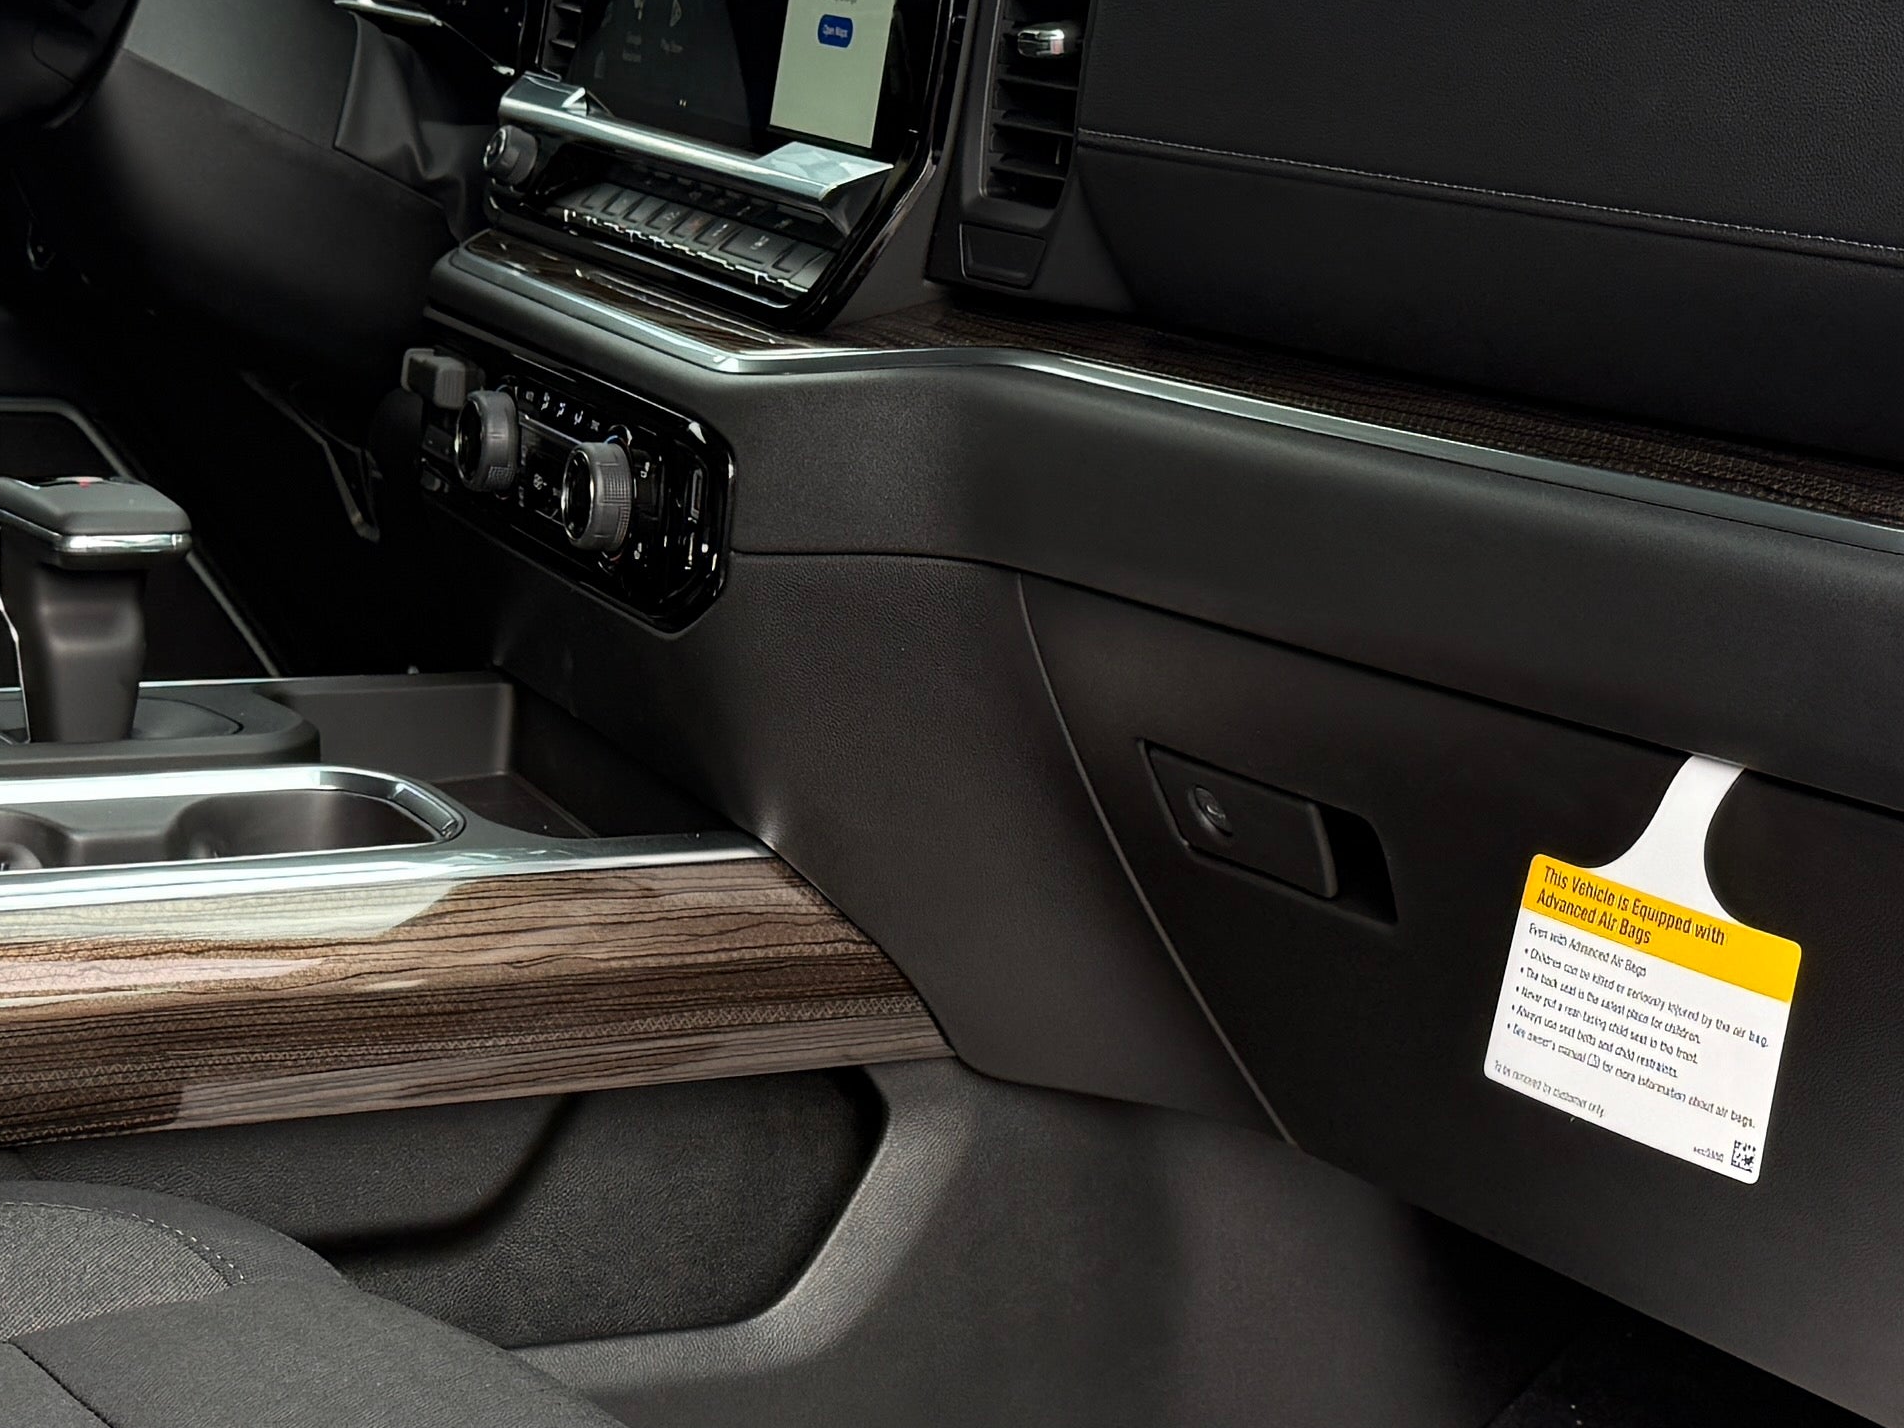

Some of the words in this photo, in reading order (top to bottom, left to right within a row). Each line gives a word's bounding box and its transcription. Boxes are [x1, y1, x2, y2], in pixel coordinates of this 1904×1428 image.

[1536, 888, 1596, 923] Advanced
[1597, 911, 1617, 931] Air
[1619, 918, 1651, 944] Bags
[1544, 865, 1568, 889] This
[1572, 877, 1615, 906] Vehicle
[1631, 898, 1692, 933] Equipped
[1695, 923, 1724, 945] with
